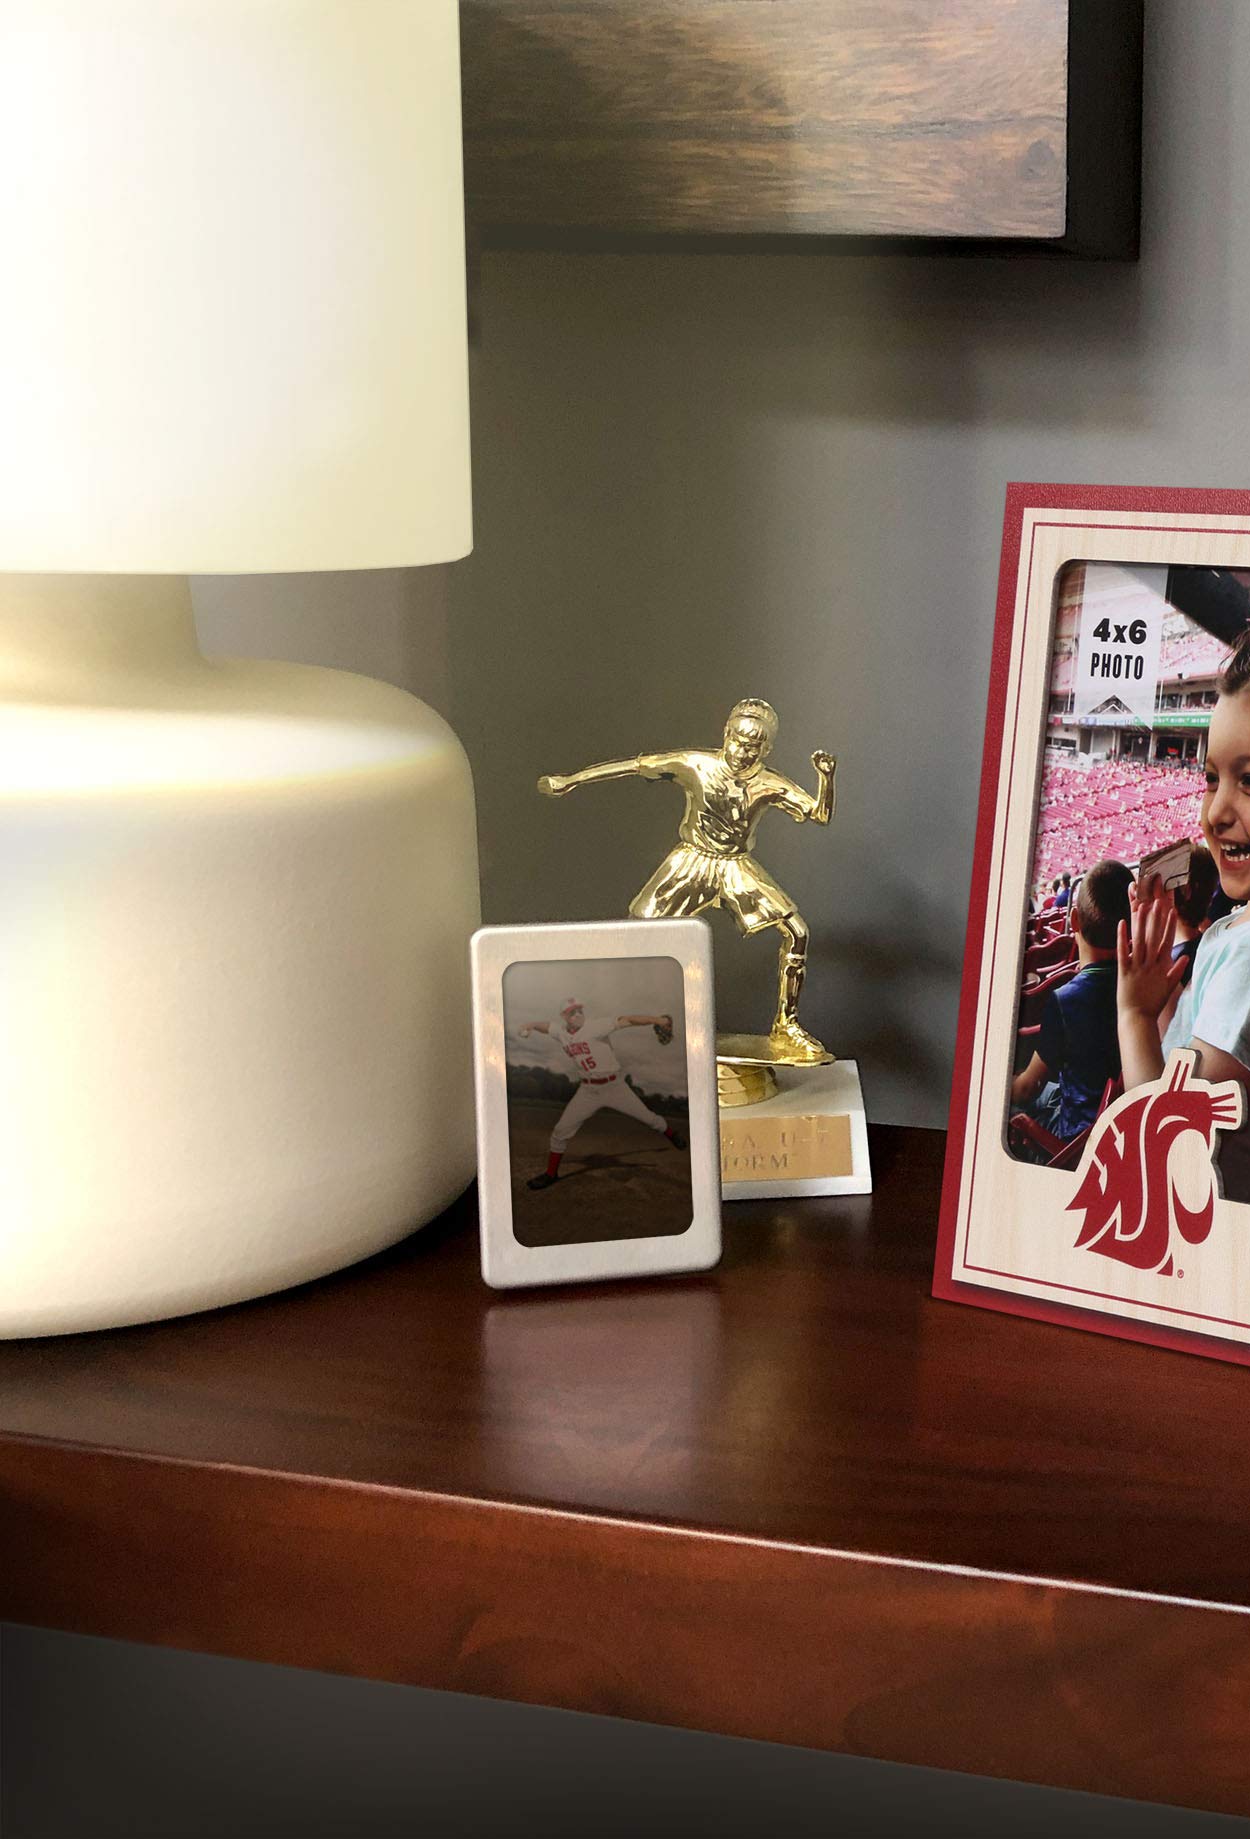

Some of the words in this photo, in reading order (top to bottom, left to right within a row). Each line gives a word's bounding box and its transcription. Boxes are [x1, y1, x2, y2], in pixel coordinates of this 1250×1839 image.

[1092, 617, 1148, 645] 4x6
[1090, 652, 1144, 680] PHOTO
[580, 1055, 597, 1072] 15
